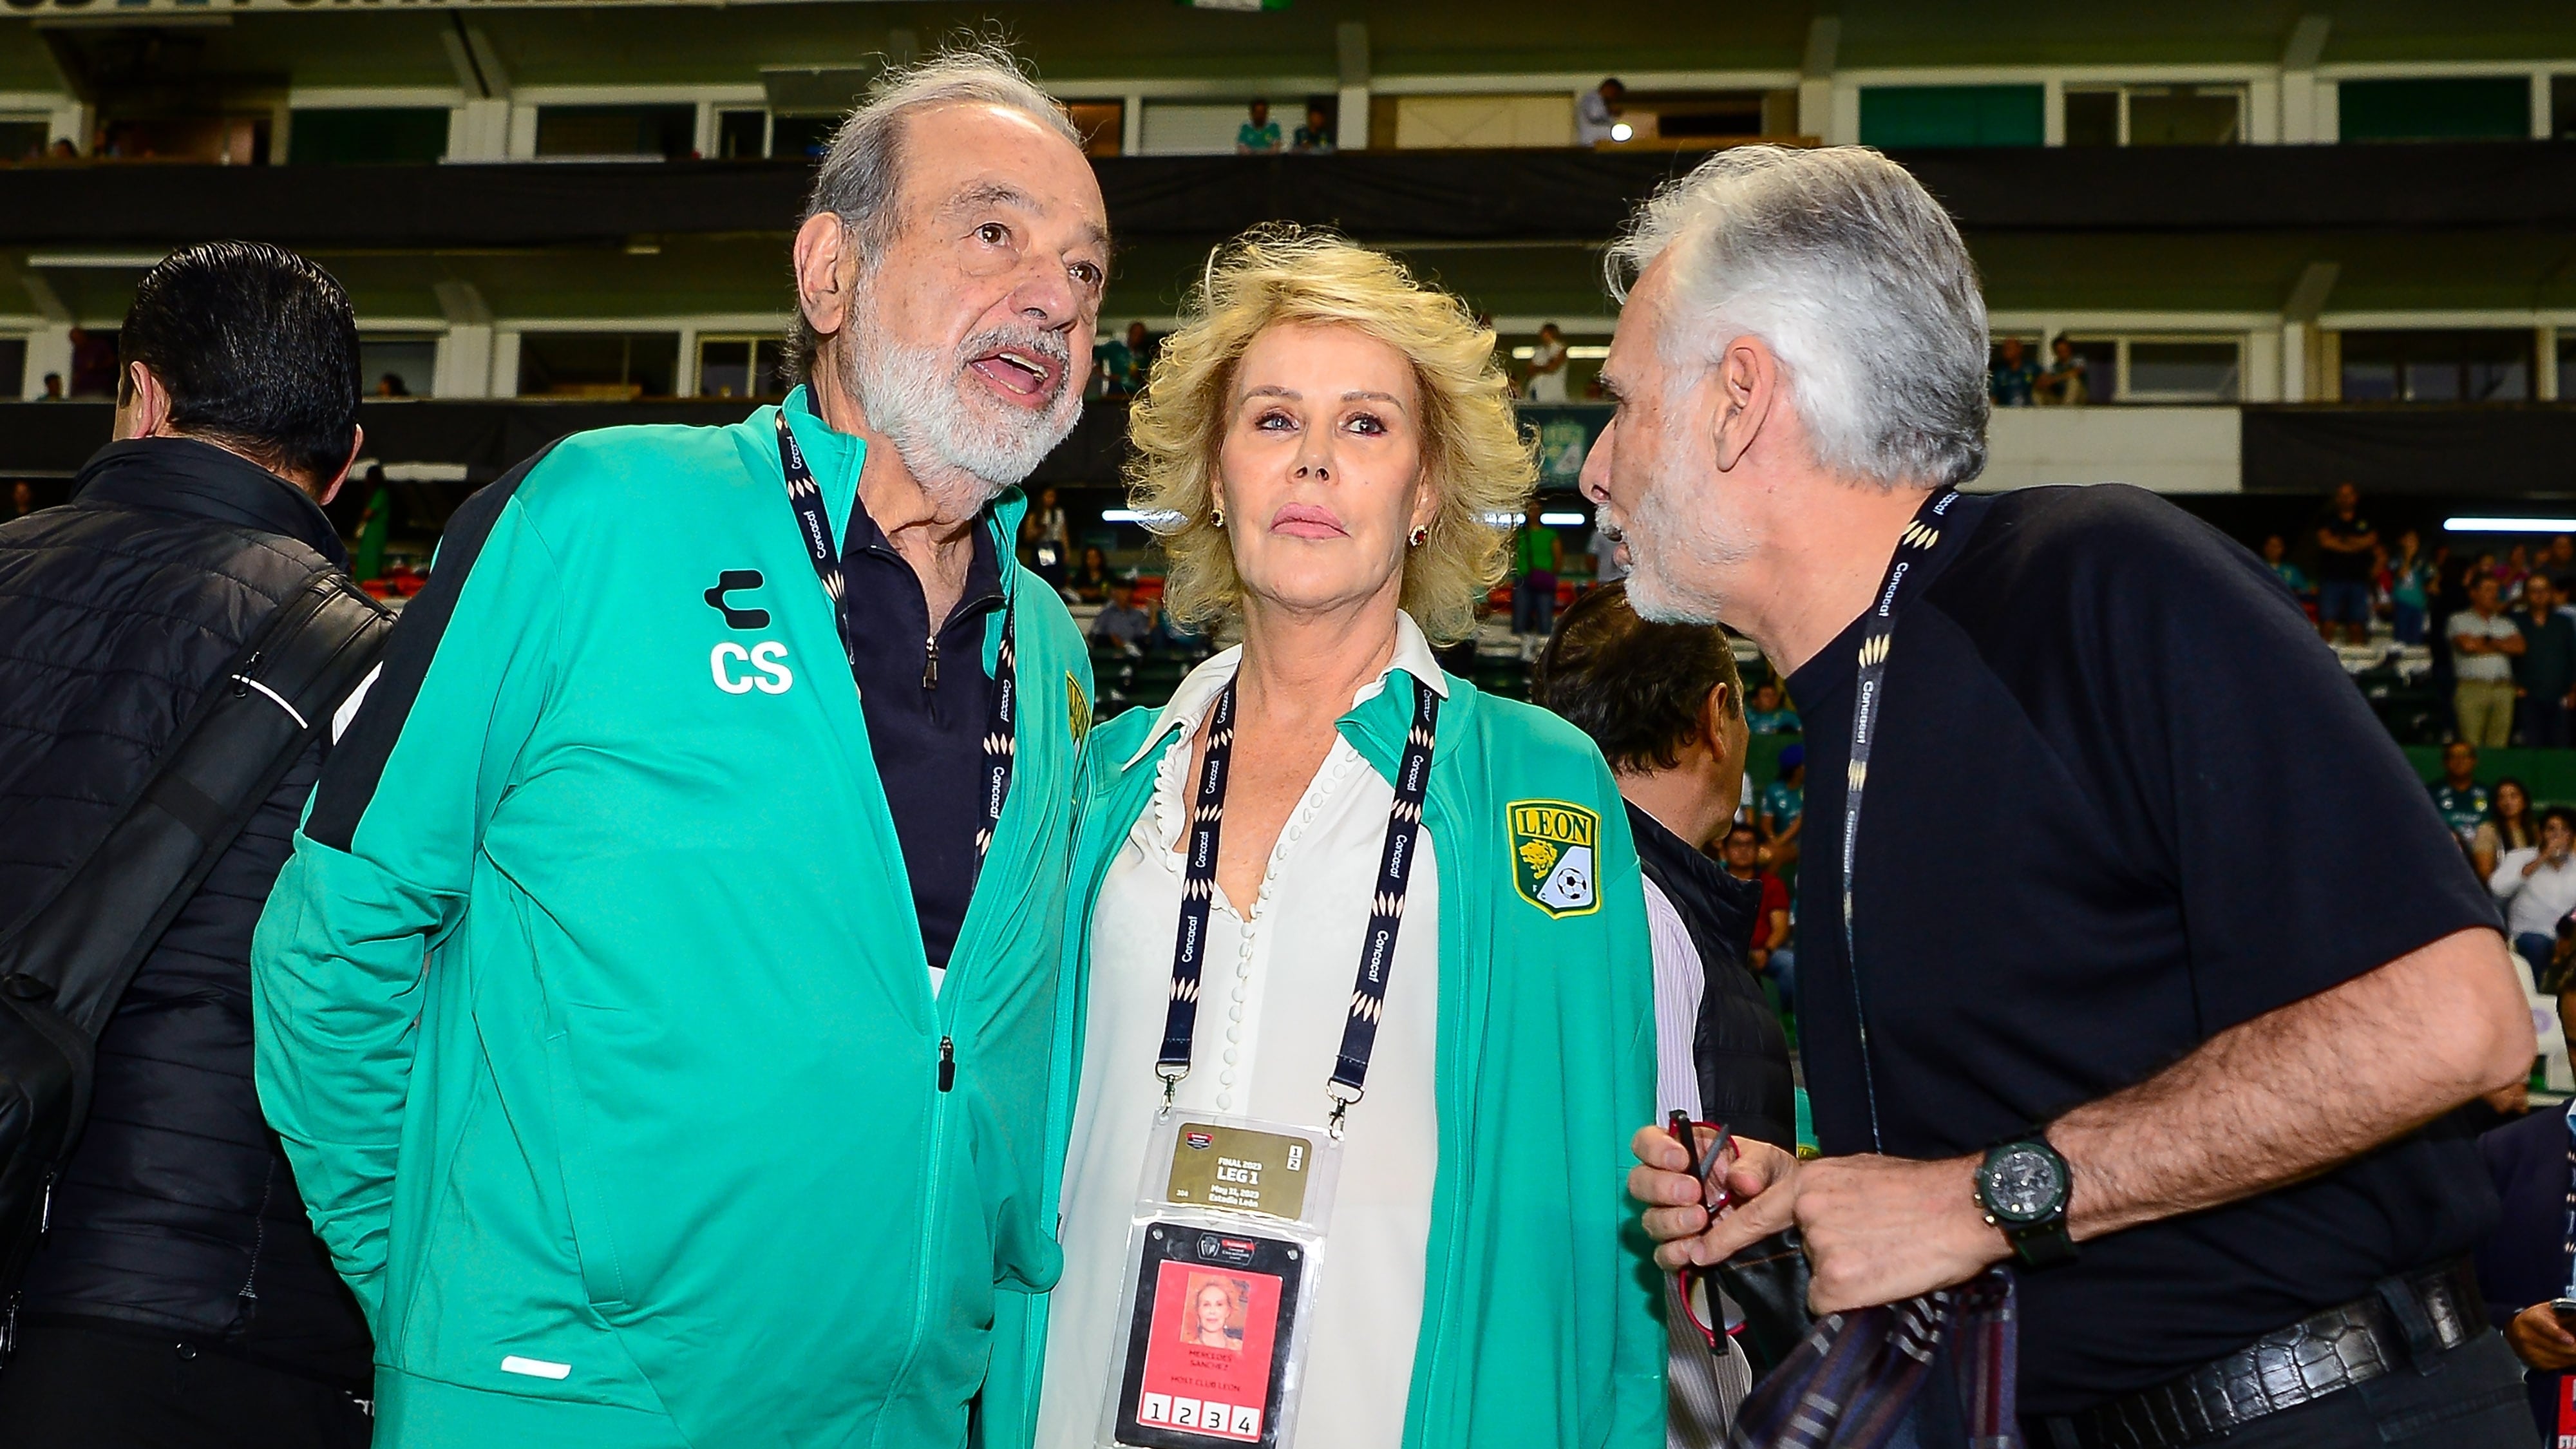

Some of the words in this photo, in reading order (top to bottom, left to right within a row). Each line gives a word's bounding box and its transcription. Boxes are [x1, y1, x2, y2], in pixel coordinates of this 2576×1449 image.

[804, 511, 827, 560] Concacaf
[1879, 562, 1909, 617] Concacaf
[710, 641, 793, 694] CS
[1857, 681, 1874, 744] Concacaf
[990, 766, 1005, 819] Concacaf
[1206, 760, 1219, 795] Concacaf
[1406, 755, 1424, 791] Concacaf
[1520, 810, 1588, 844] LEON
[1195, 831, 1209, 868] Concacaf
[1390, 834, 1408, 879] Concacaf
[1182, 915, 1198, 963] Concacaf
[1368, 930, 1389, 983] Concacaf
[1217, 1157, 1242, 1168] FINAL
[1293, 1148, 1298, 1157] 1
[1217, 1166, 1248, 1183] LEG
[1249, 1171, 1258, 1185] 1
[1151, 1403, 1160, 1420] 1
[1179, 1407, 1191, 1425] 2
[1208, 1411, 1220, 1428] 3
[1238, 1416, 1250, 1434] 4
